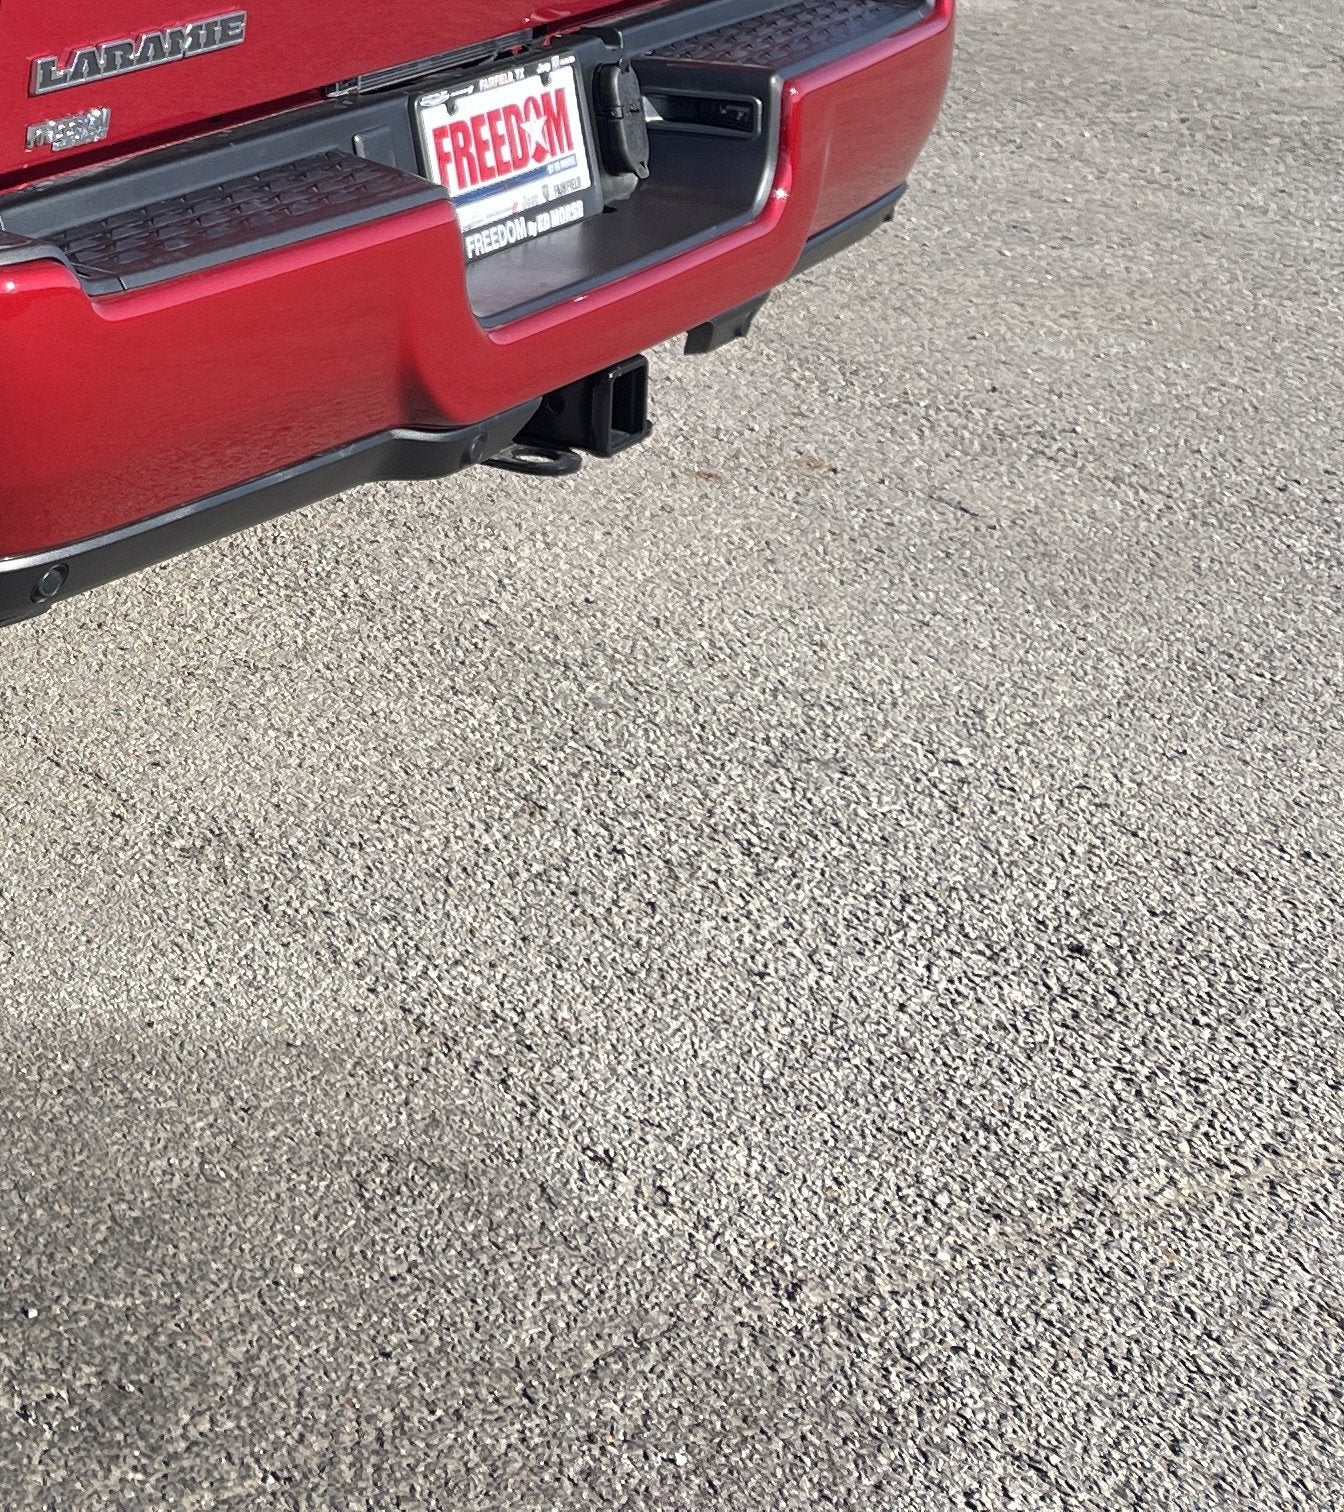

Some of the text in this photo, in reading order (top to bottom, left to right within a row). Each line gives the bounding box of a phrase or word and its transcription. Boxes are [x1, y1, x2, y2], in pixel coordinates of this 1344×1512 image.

[28, 9, 247, 96] LARAMIE
[432, 87, 575, 191] FREEDOM
[465, 216, 528, 259] FREEDOM
[536, 212, 551, 233] ED
